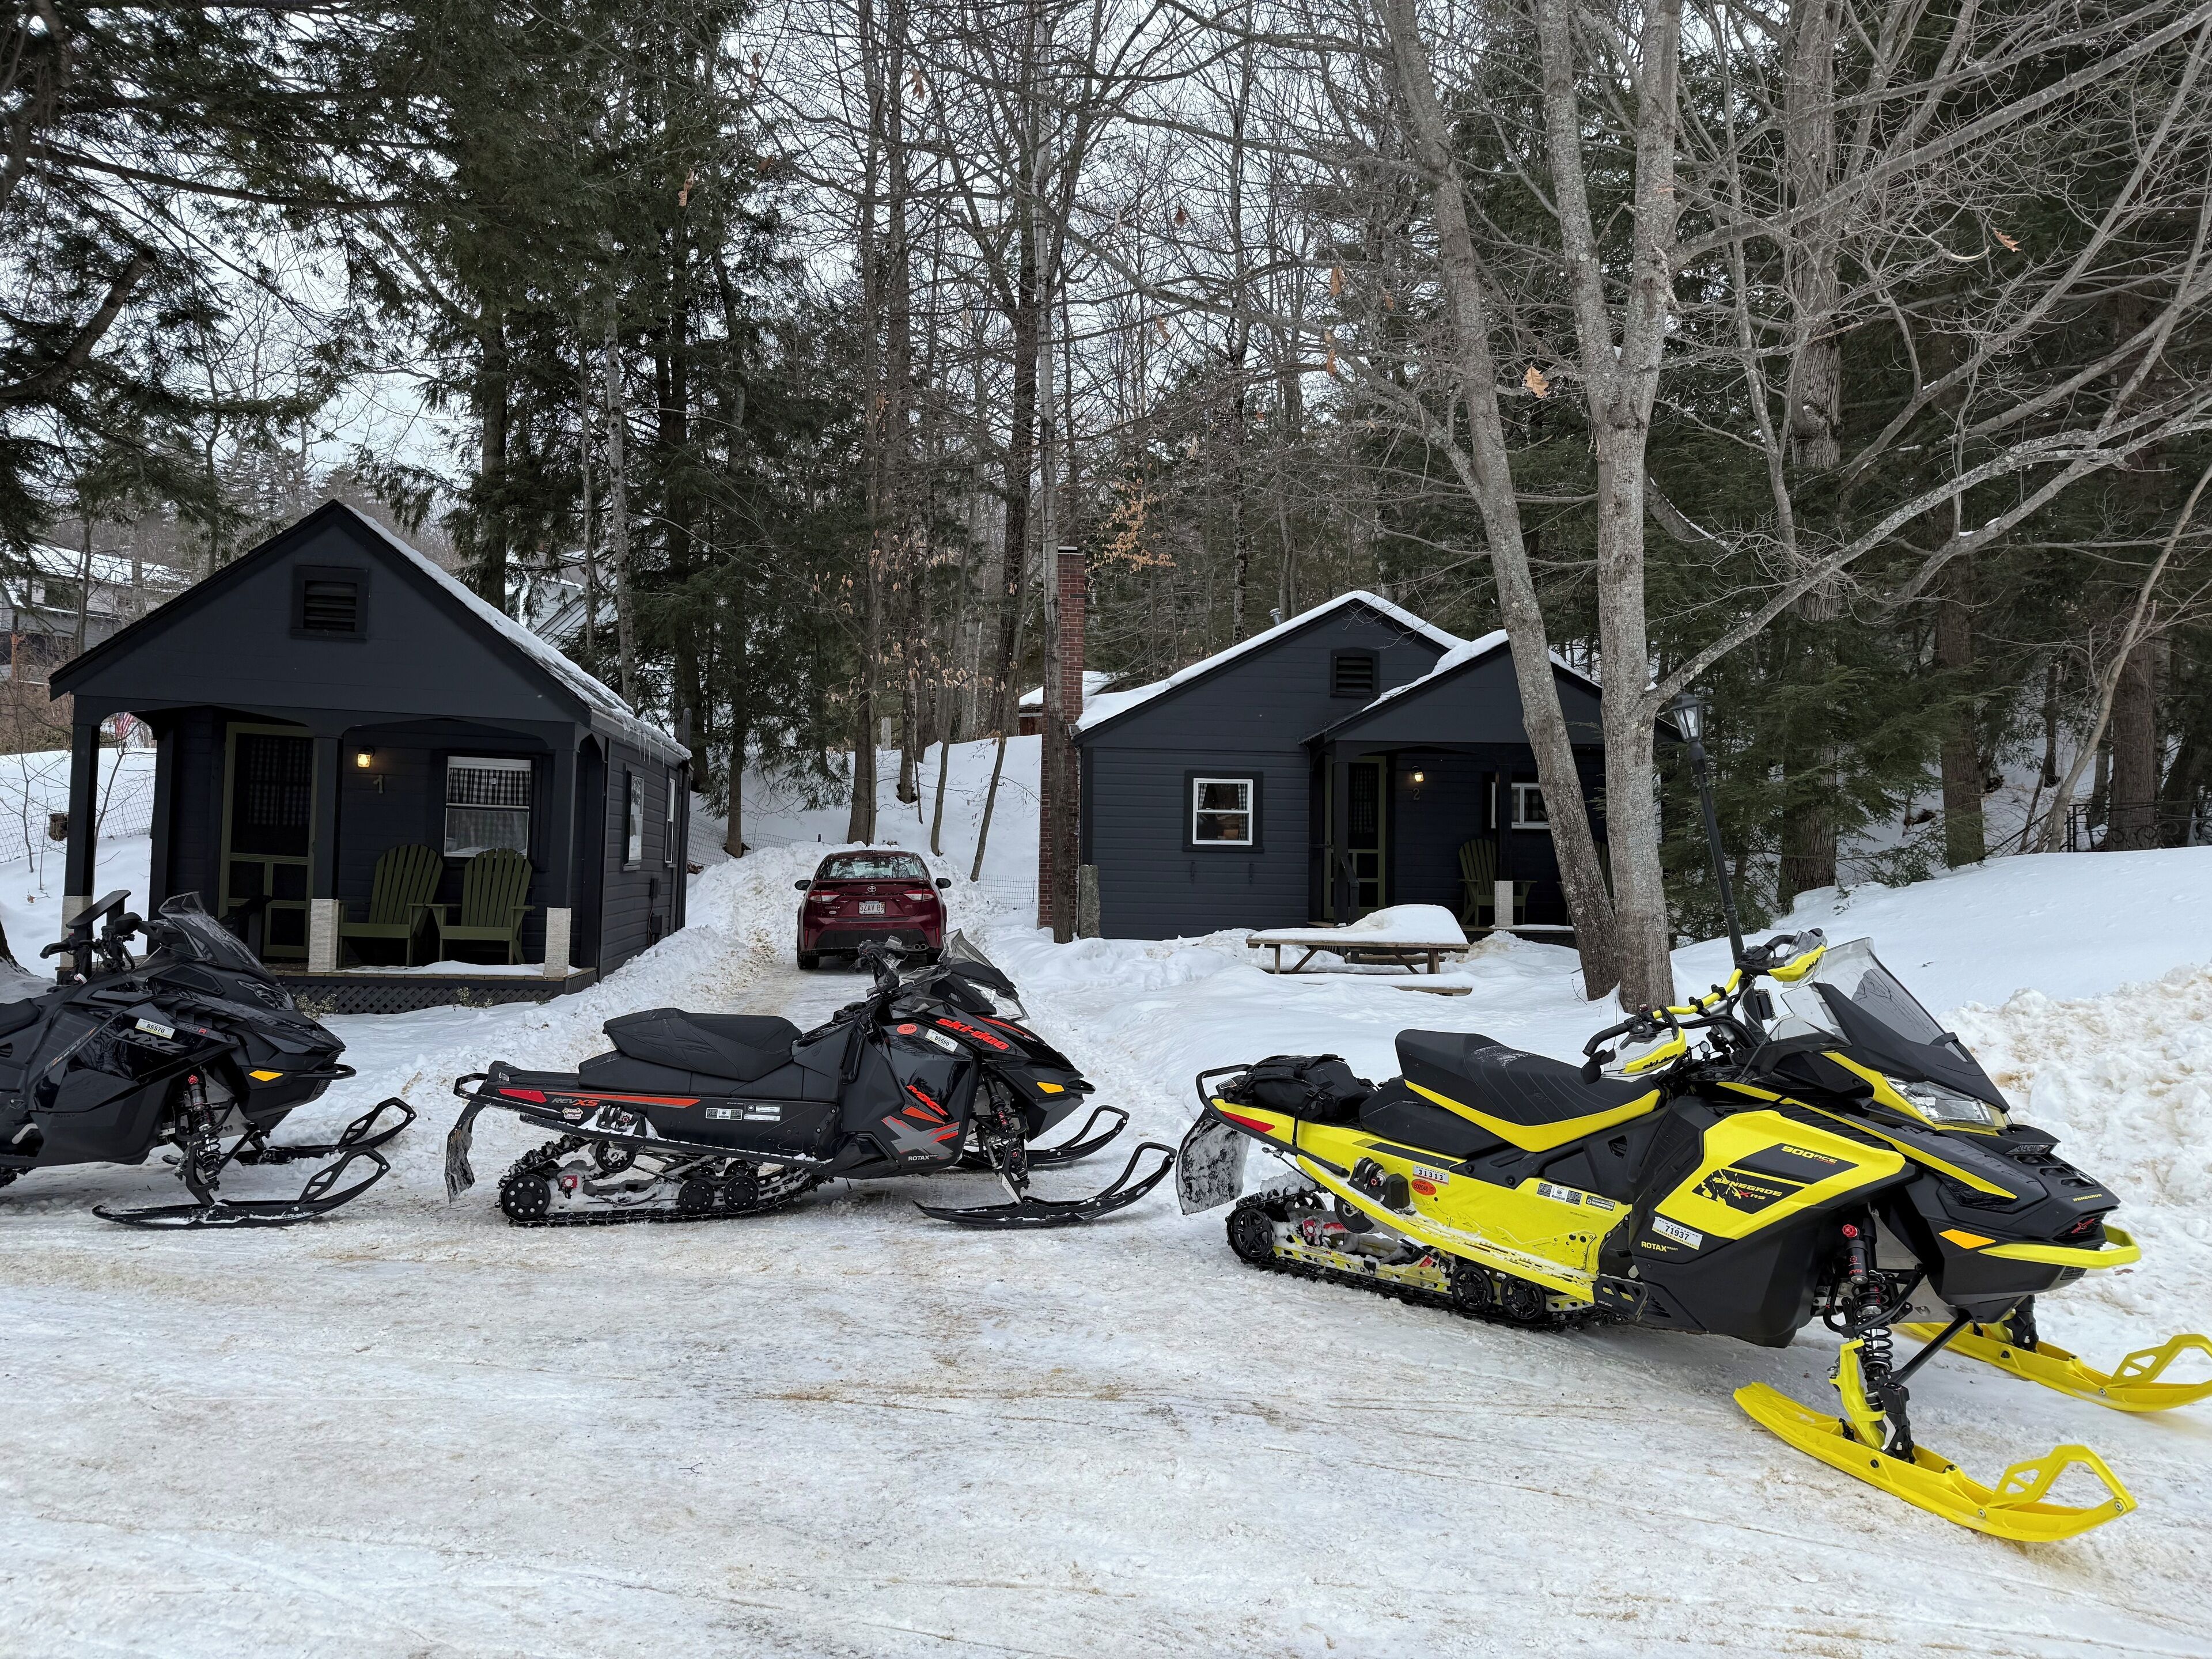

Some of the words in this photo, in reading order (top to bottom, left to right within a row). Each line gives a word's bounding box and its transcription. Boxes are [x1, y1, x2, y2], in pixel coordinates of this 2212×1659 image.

[1413, 788, 1420, 801] 2
[146, 1024, 165, 1033] 85570
[935, 1018, 1009, 1050] ski-doo
[116, 1028, 189, 1053] MXZ
[906, 1085, 948, 1116] MXZ
[1419, 1169, 1443, 1180] 31313
[1713, 1177, 1783, 1196] RENEGADE
[1665, 1225, 1690, 1240] 71937
[1641, 1241, 1667, 1252] ROTAX
